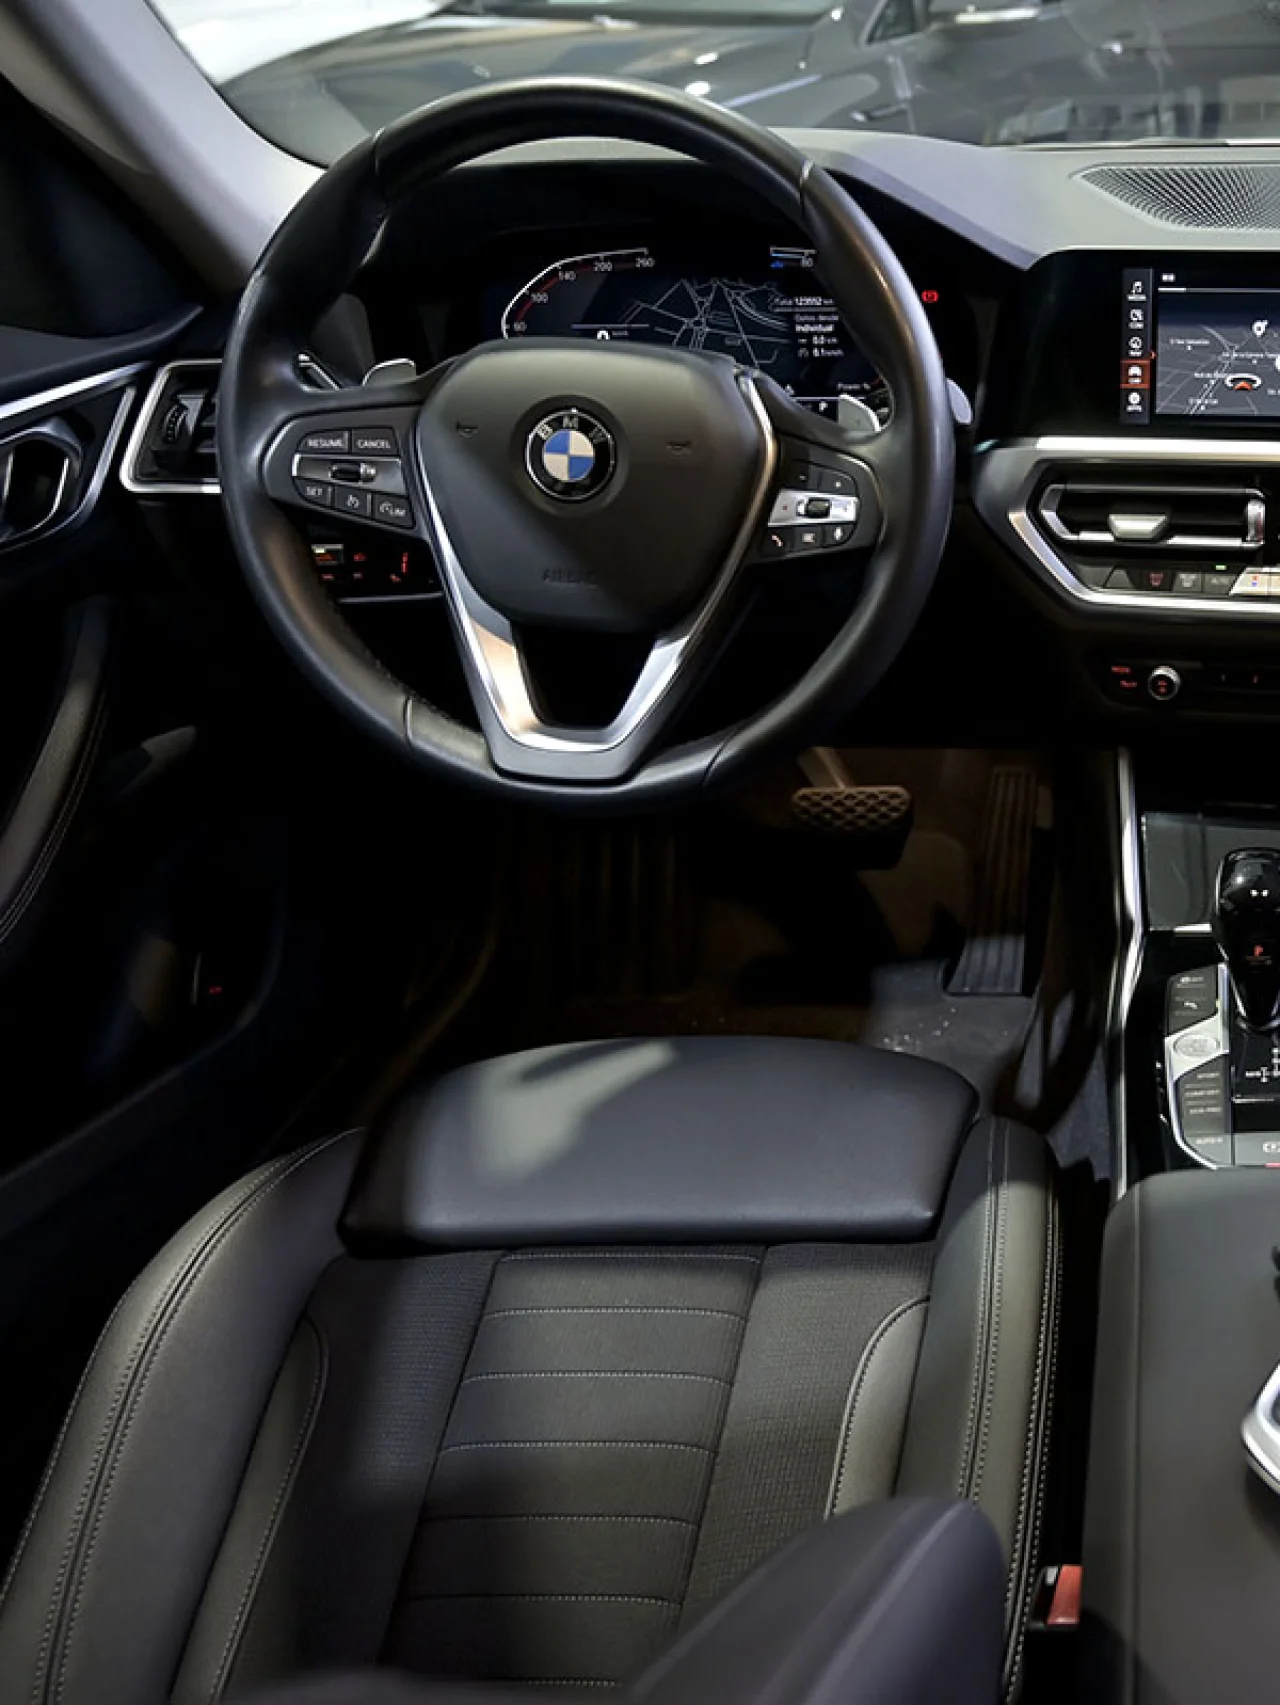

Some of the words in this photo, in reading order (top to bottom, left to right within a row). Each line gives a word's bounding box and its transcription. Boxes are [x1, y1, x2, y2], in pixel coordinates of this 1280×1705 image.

[536, 414, 607, 445] BMW
[307, 439, 344, 449] RESUME
[357, 439, 391, 449] CANCEL
